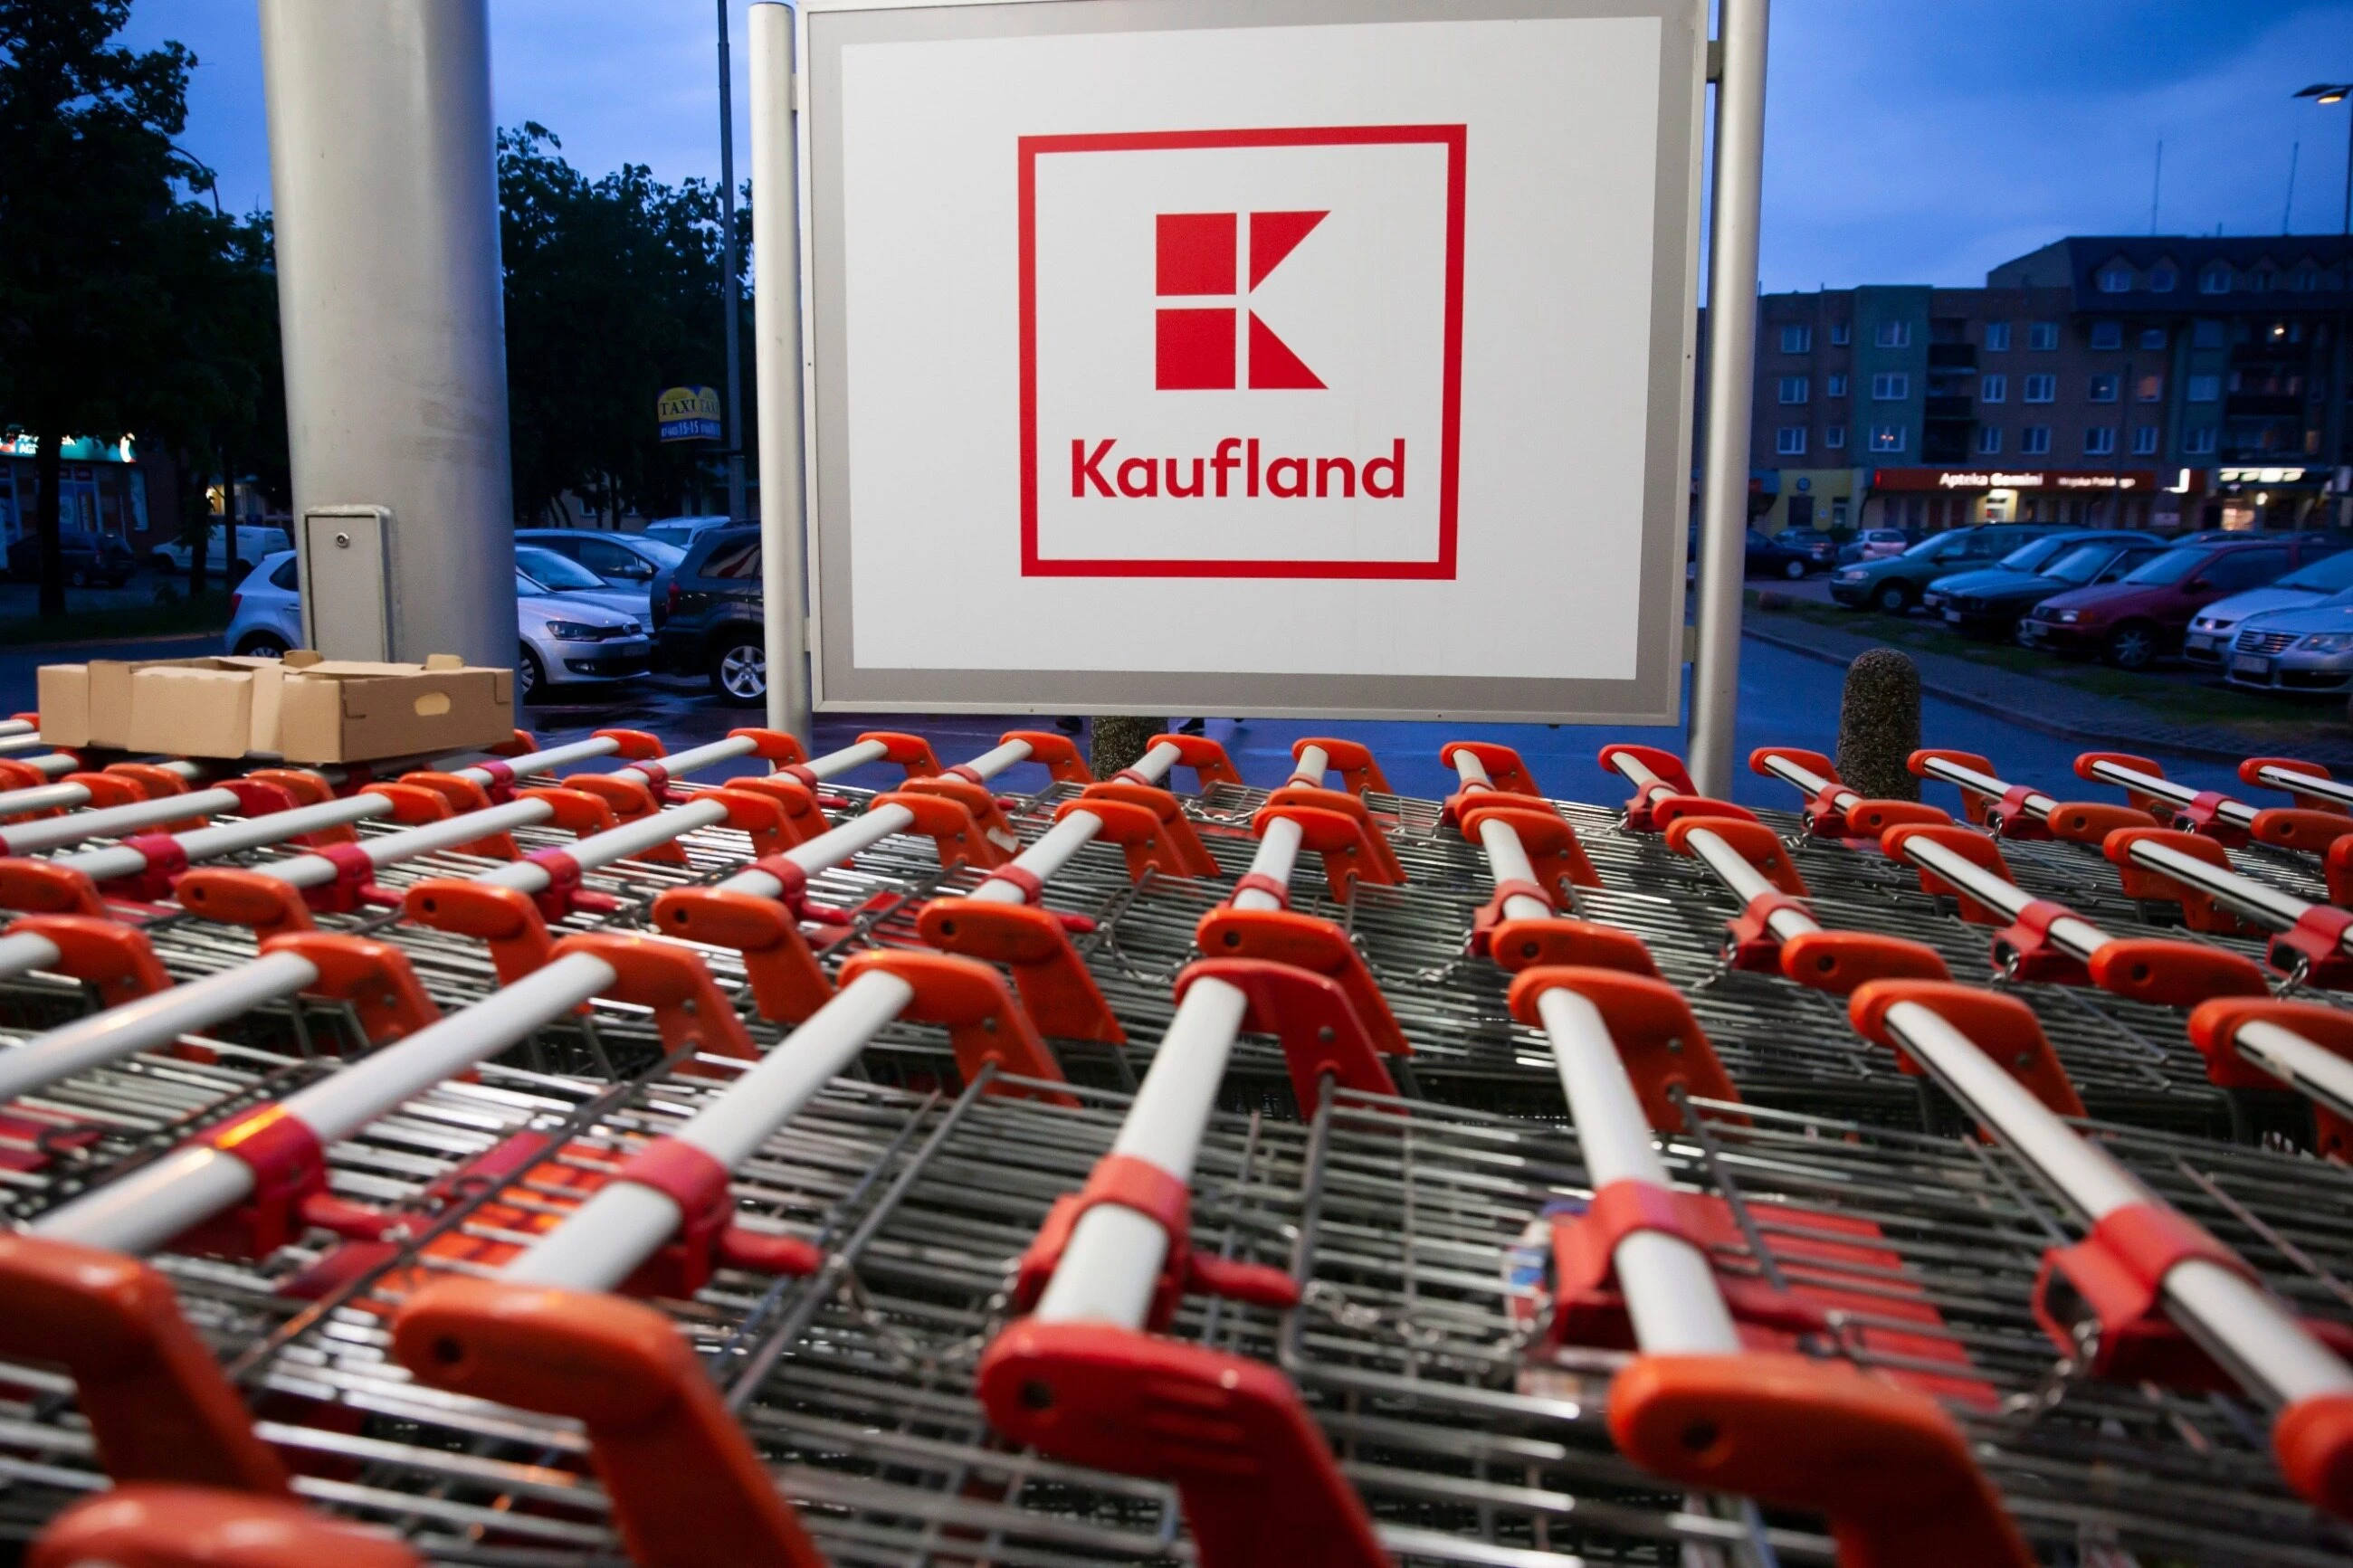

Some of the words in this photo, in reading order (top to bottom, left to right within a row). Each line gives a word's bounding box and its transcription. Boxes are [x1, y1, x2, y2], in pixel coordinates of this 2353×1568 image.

[660, 399, 696, 416] TAXI
[1072, 438, 1405, 499] Kaufland
[1939, 472, 1988, 489] Apteka
[1990, 472, 2043, 487] Gemini
